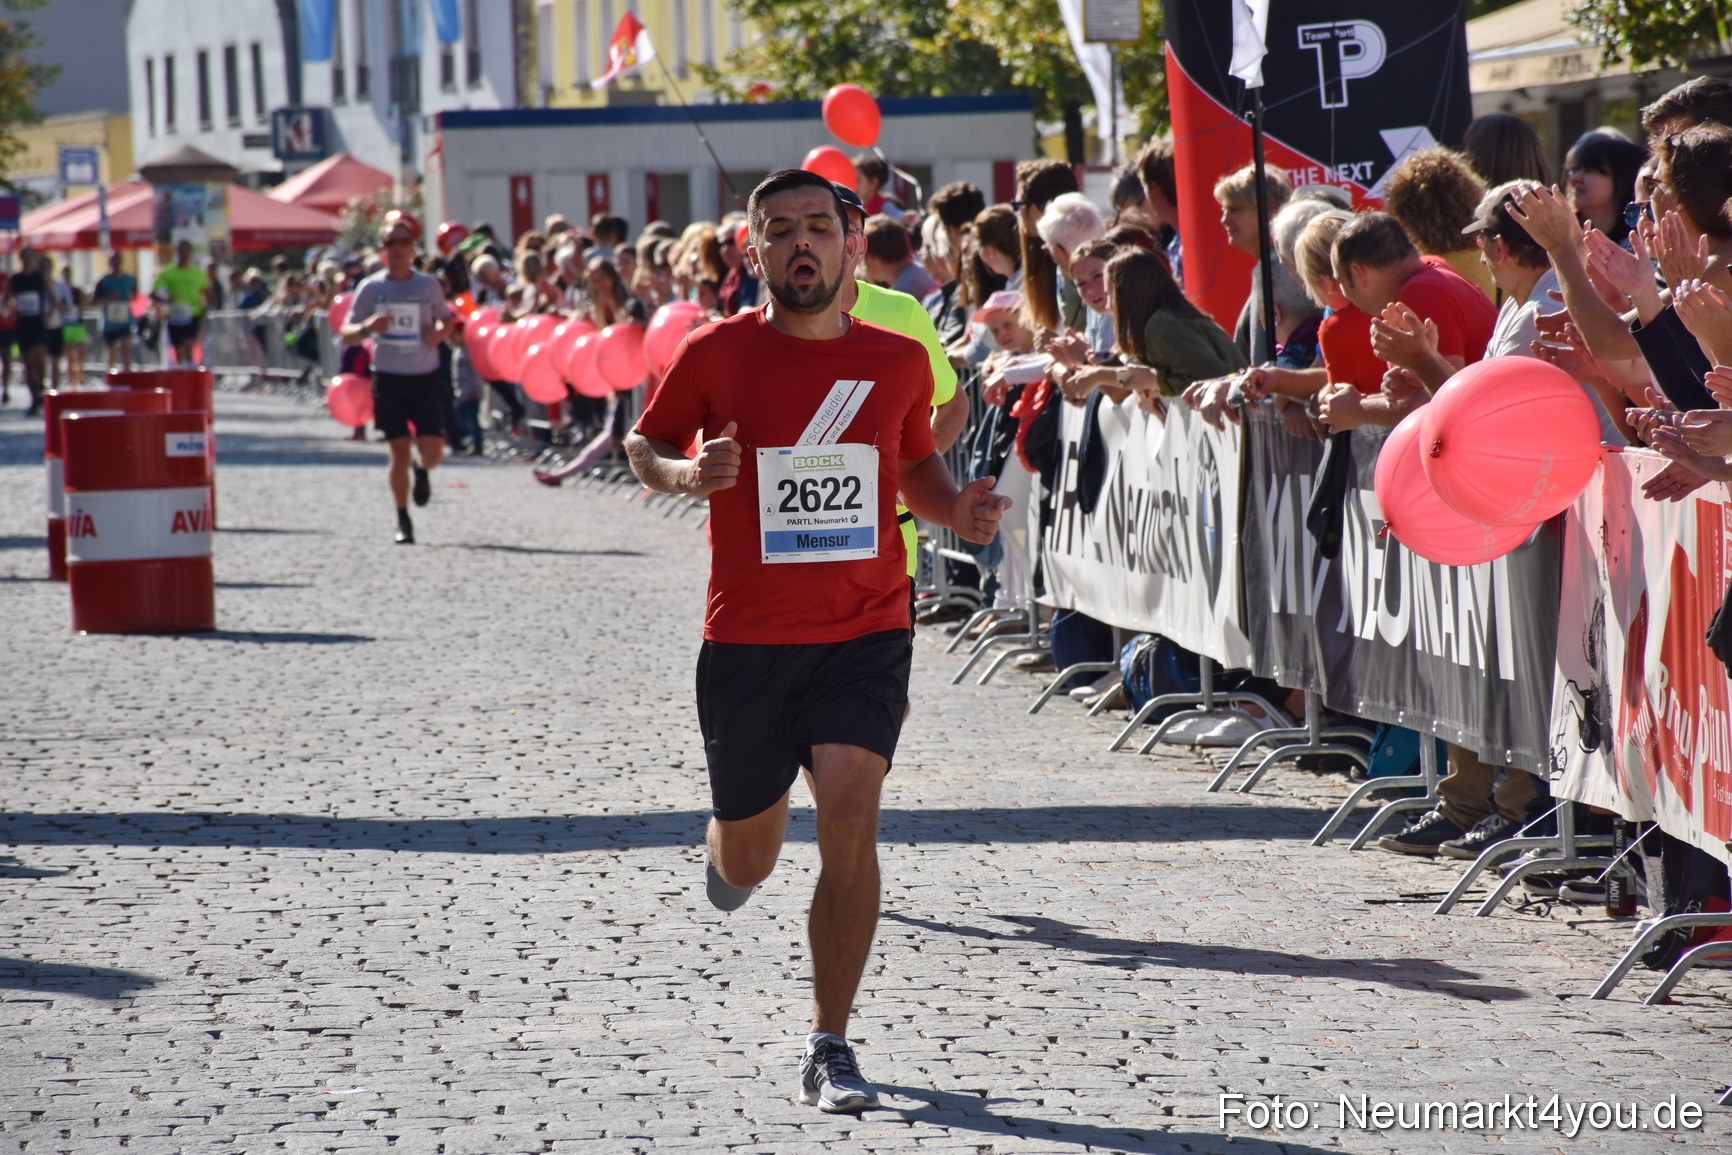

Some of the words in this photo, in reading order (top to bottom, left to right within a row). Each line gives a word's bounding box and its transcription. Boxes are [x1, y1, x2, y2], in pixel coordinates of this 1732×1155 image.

[1304, 31, 1331, 41] Team
[1323, 161, 1374, 183] NEXT
[793, 454, 845, 469] BOCK
[778, 476, 863, 513] 2622
[787, 518, 812, 526] PARTL
[814, 516, 848, 525] Neumarkt
[796, 534, 850, 549] Mensur
